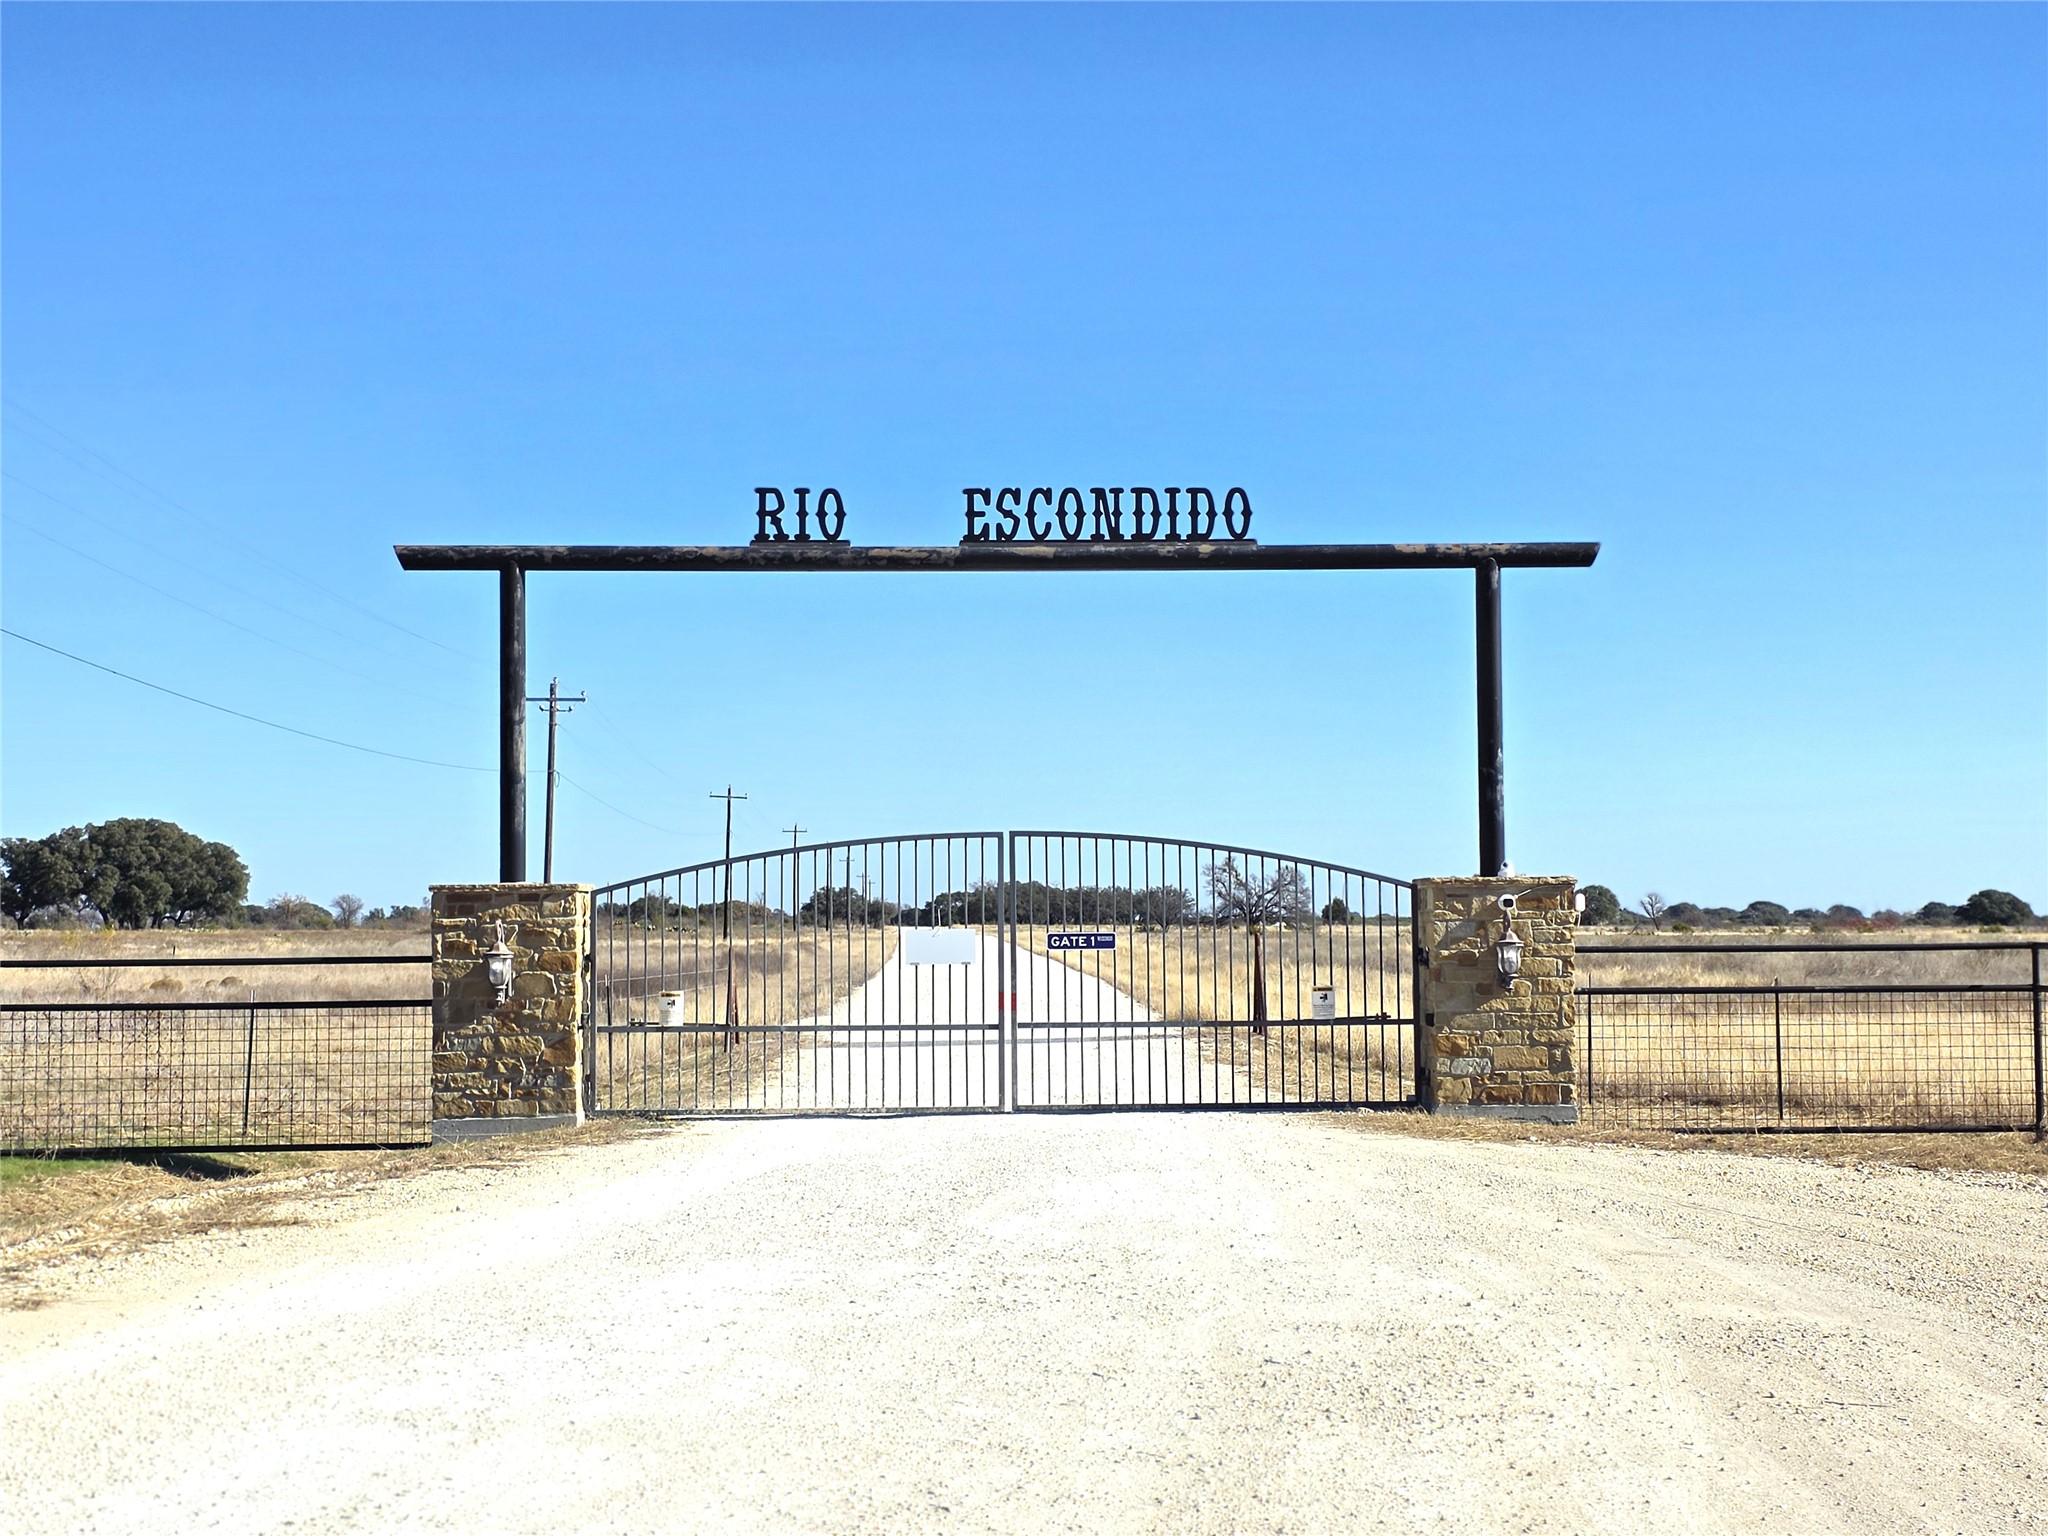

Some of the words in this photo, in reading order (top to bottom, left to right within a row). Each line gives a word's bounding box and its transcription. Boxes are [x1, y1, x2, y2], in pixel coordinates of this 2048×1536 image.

[754, 487, 847, 541] RIO
[962, 487, 1253, 541] ESCONDIDO
[1051, 936, 1087, 947] GATE
[1090, 936, 1095, 947] 1
